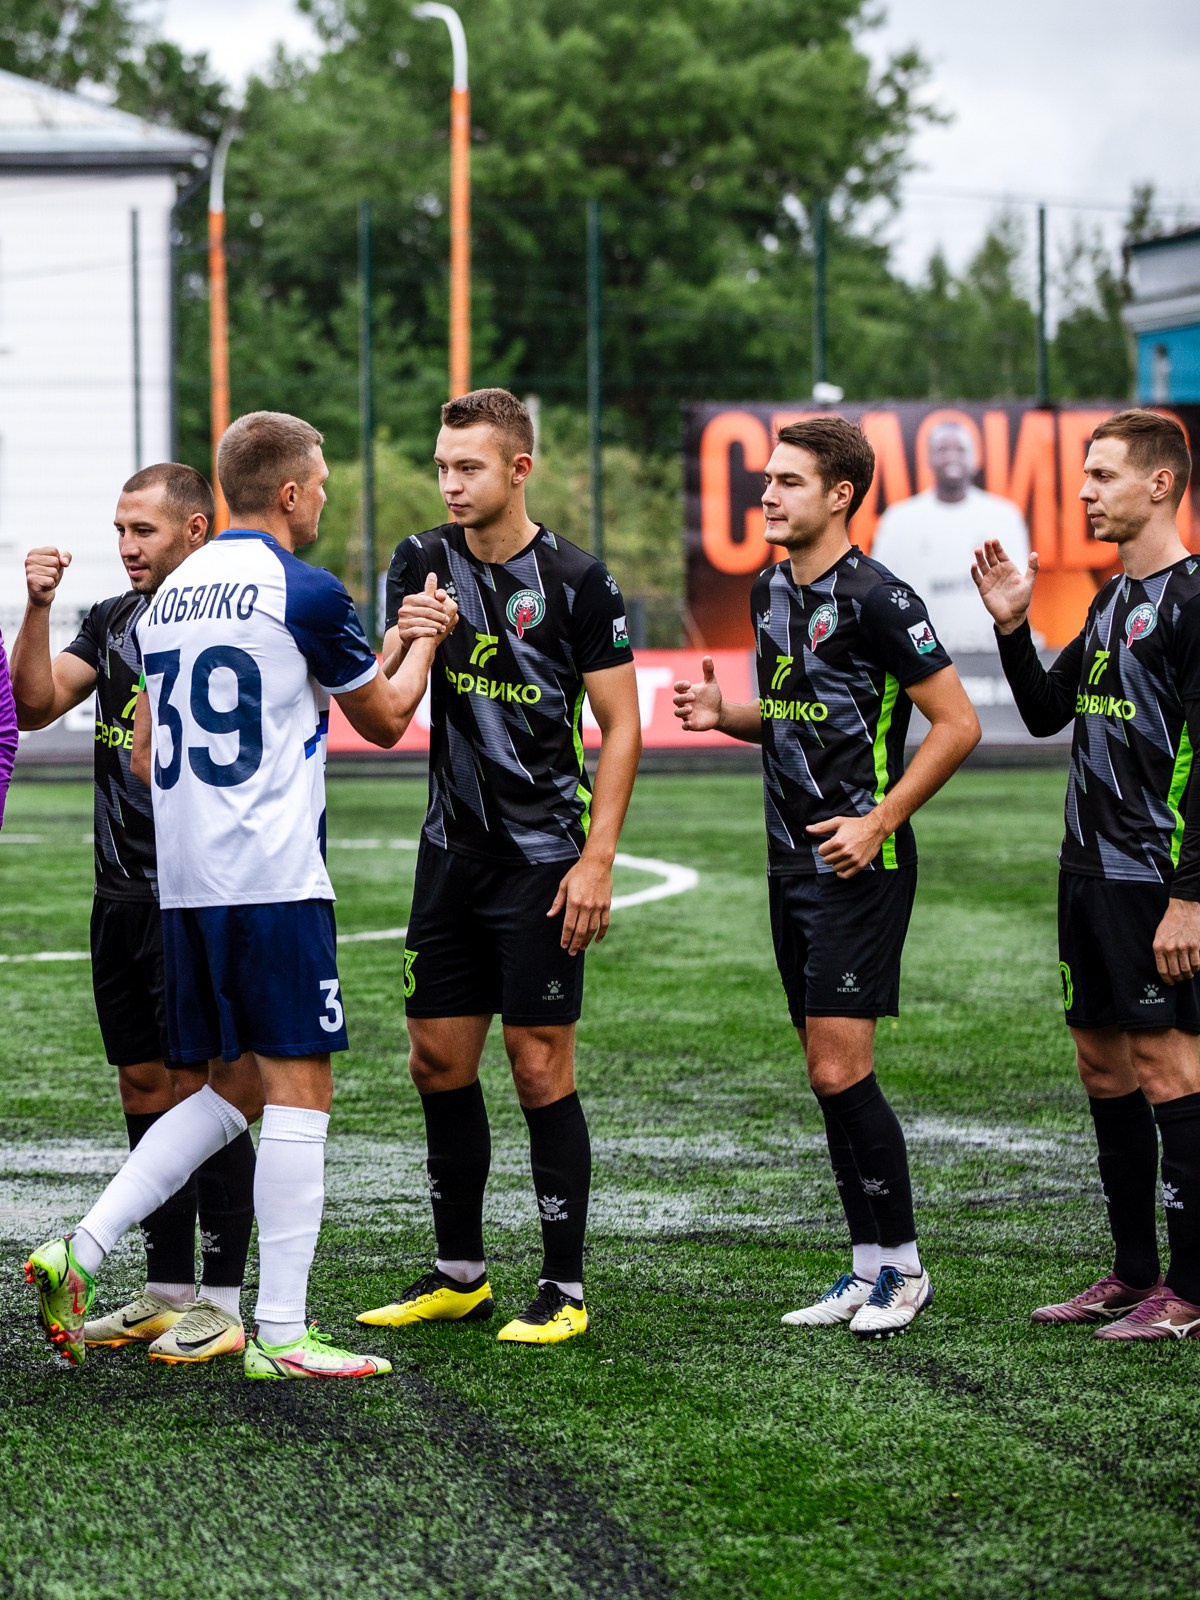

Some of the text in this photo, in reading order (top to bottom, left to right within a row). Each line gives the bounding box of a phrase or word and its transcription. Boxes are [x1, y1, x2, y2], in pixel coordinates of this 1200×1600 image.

[148, 582, 259, 627] КОБЯЛКО
[445, 665, 542, 705] ервико
[143, 645, 264, 790] 39
[760, 697, 828, 722] ервико
[1075, 694, 1137, 721] ервико
[94, 720, 134, 750] серв
[319, 978, 344, 1033] 3
[1139, 997, 1166, 1005] KELME
